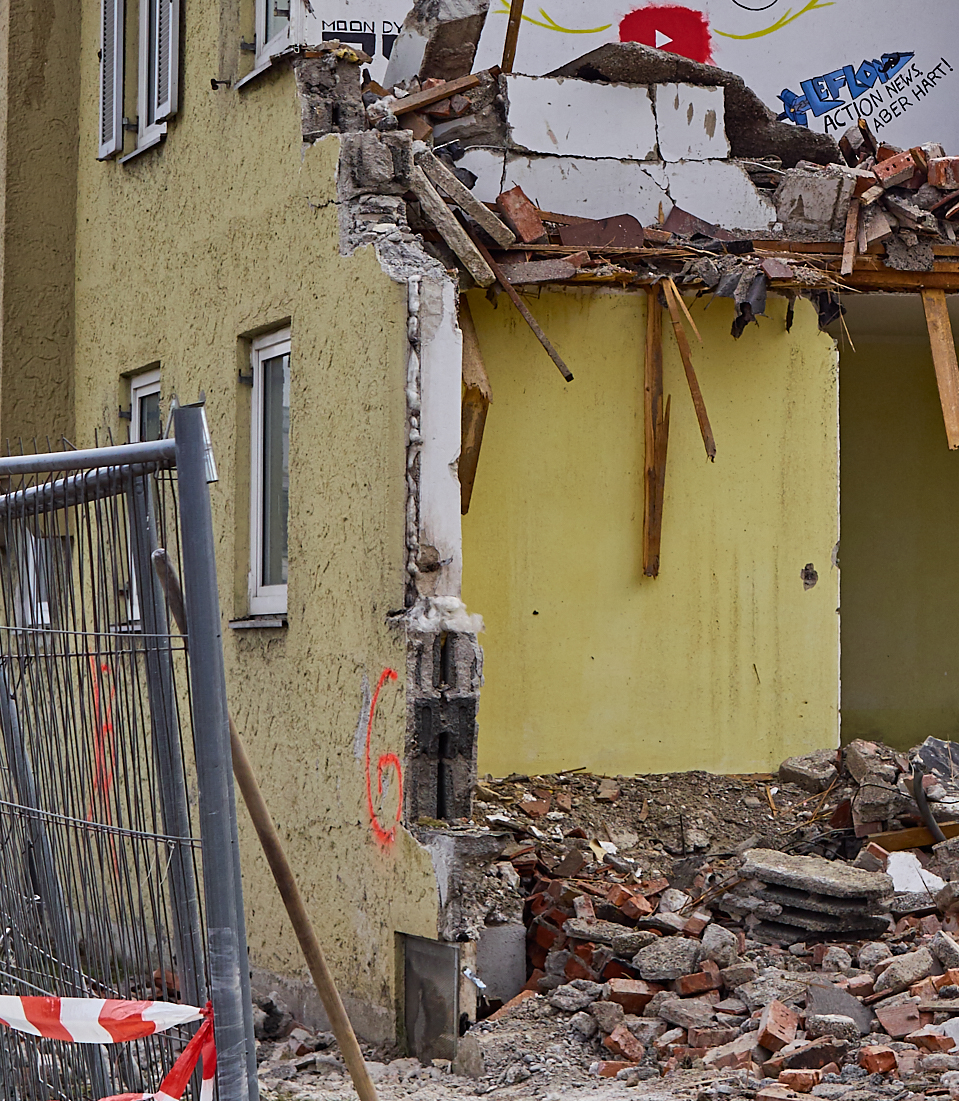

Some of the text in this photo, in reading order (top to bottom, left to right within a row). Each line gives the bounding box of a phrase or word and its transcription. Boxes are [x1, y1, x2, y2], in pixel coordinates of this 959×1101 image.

[321, 20, 375, 33] MOON
[823, 89, 884, 134] ACTION
[872, 57, 954, 134] ABER HART!
